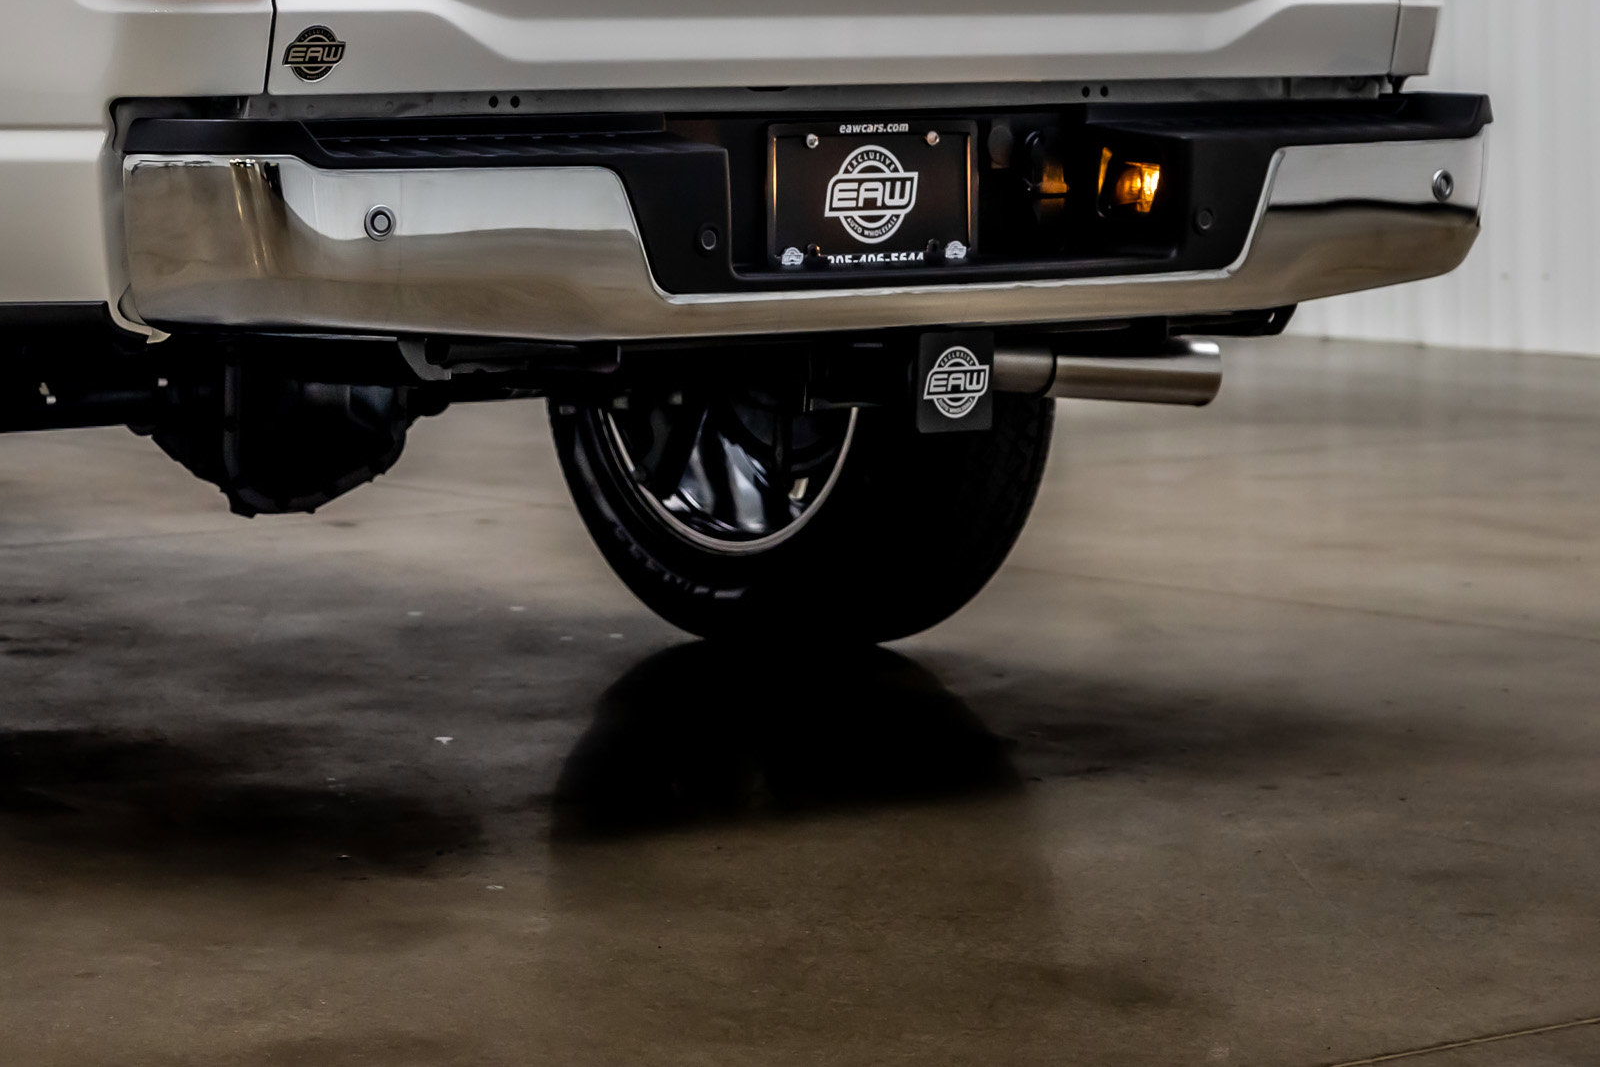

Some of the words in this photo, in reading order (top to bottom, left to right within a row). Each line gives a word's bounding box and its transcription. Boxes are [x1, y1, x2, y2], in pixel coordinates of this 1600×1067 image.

[287, 46, 342, 62] EAW
[839, 122, 909, 134] eawcars.com
[846, 151, 896, 172] EXCLUSIVE
[831, 180, 912, 209] EAW
[846, 217, 863, 234] AUTO
[928, 371, 985, 393] EAW
